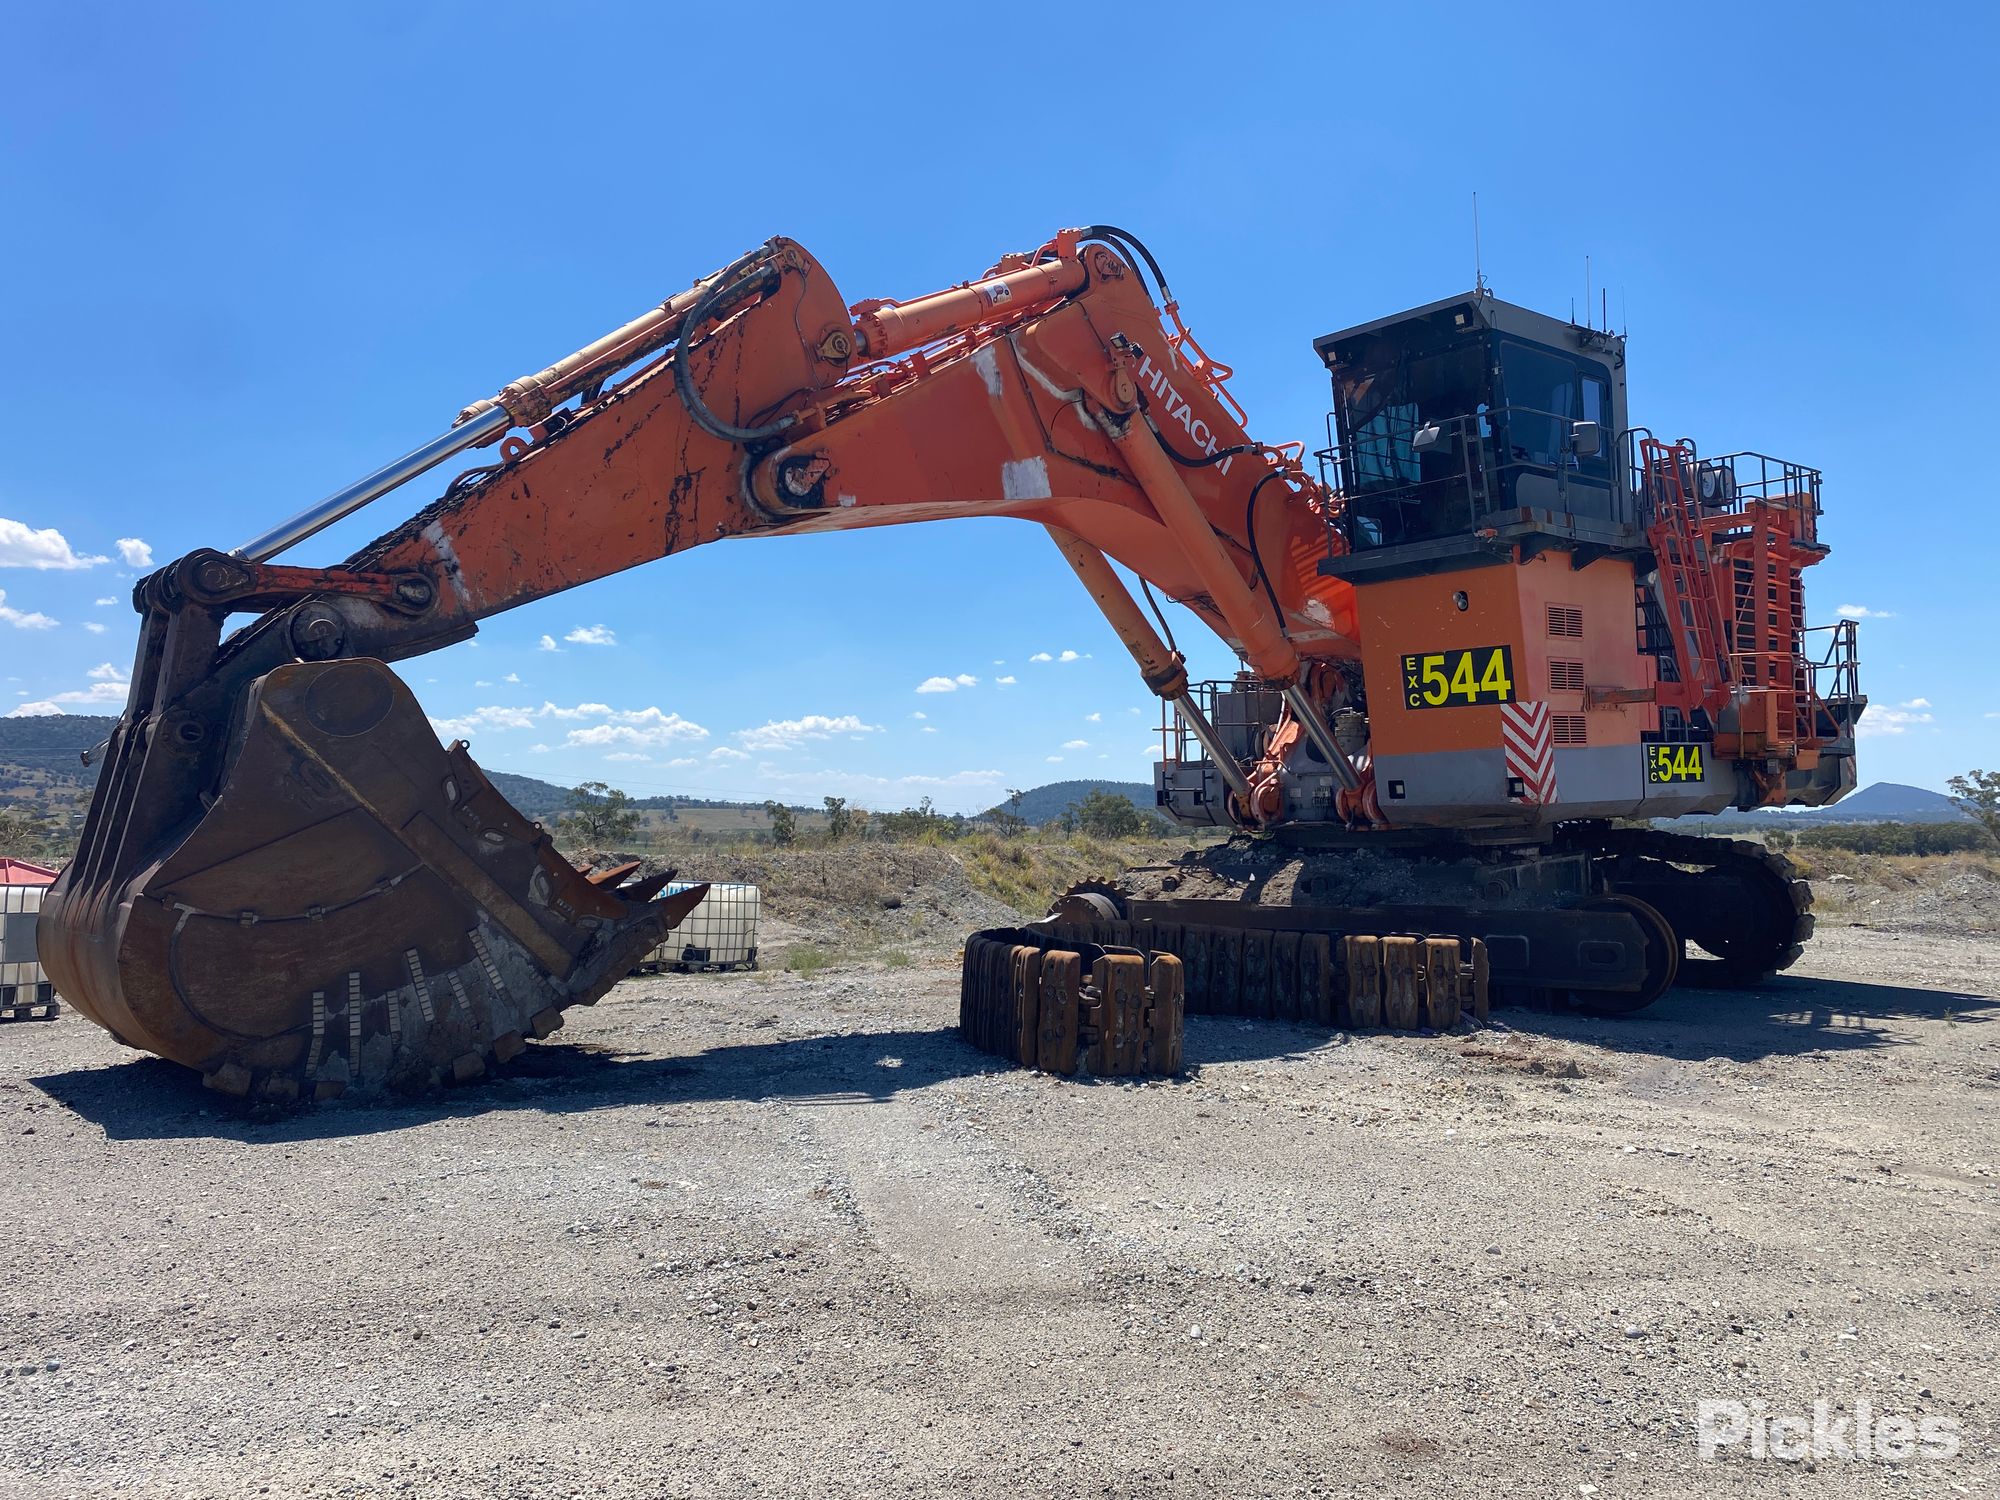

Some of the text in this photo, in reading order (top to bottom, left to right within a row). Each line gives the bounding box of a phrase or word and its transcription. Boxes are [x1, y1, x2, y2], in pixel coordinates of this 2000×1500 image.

[1138, 355, 1232, 476] HITACHI
[1405, 648, 1511, 707] EXC 544
[1649, 746, 1703, 782] EXC 544
